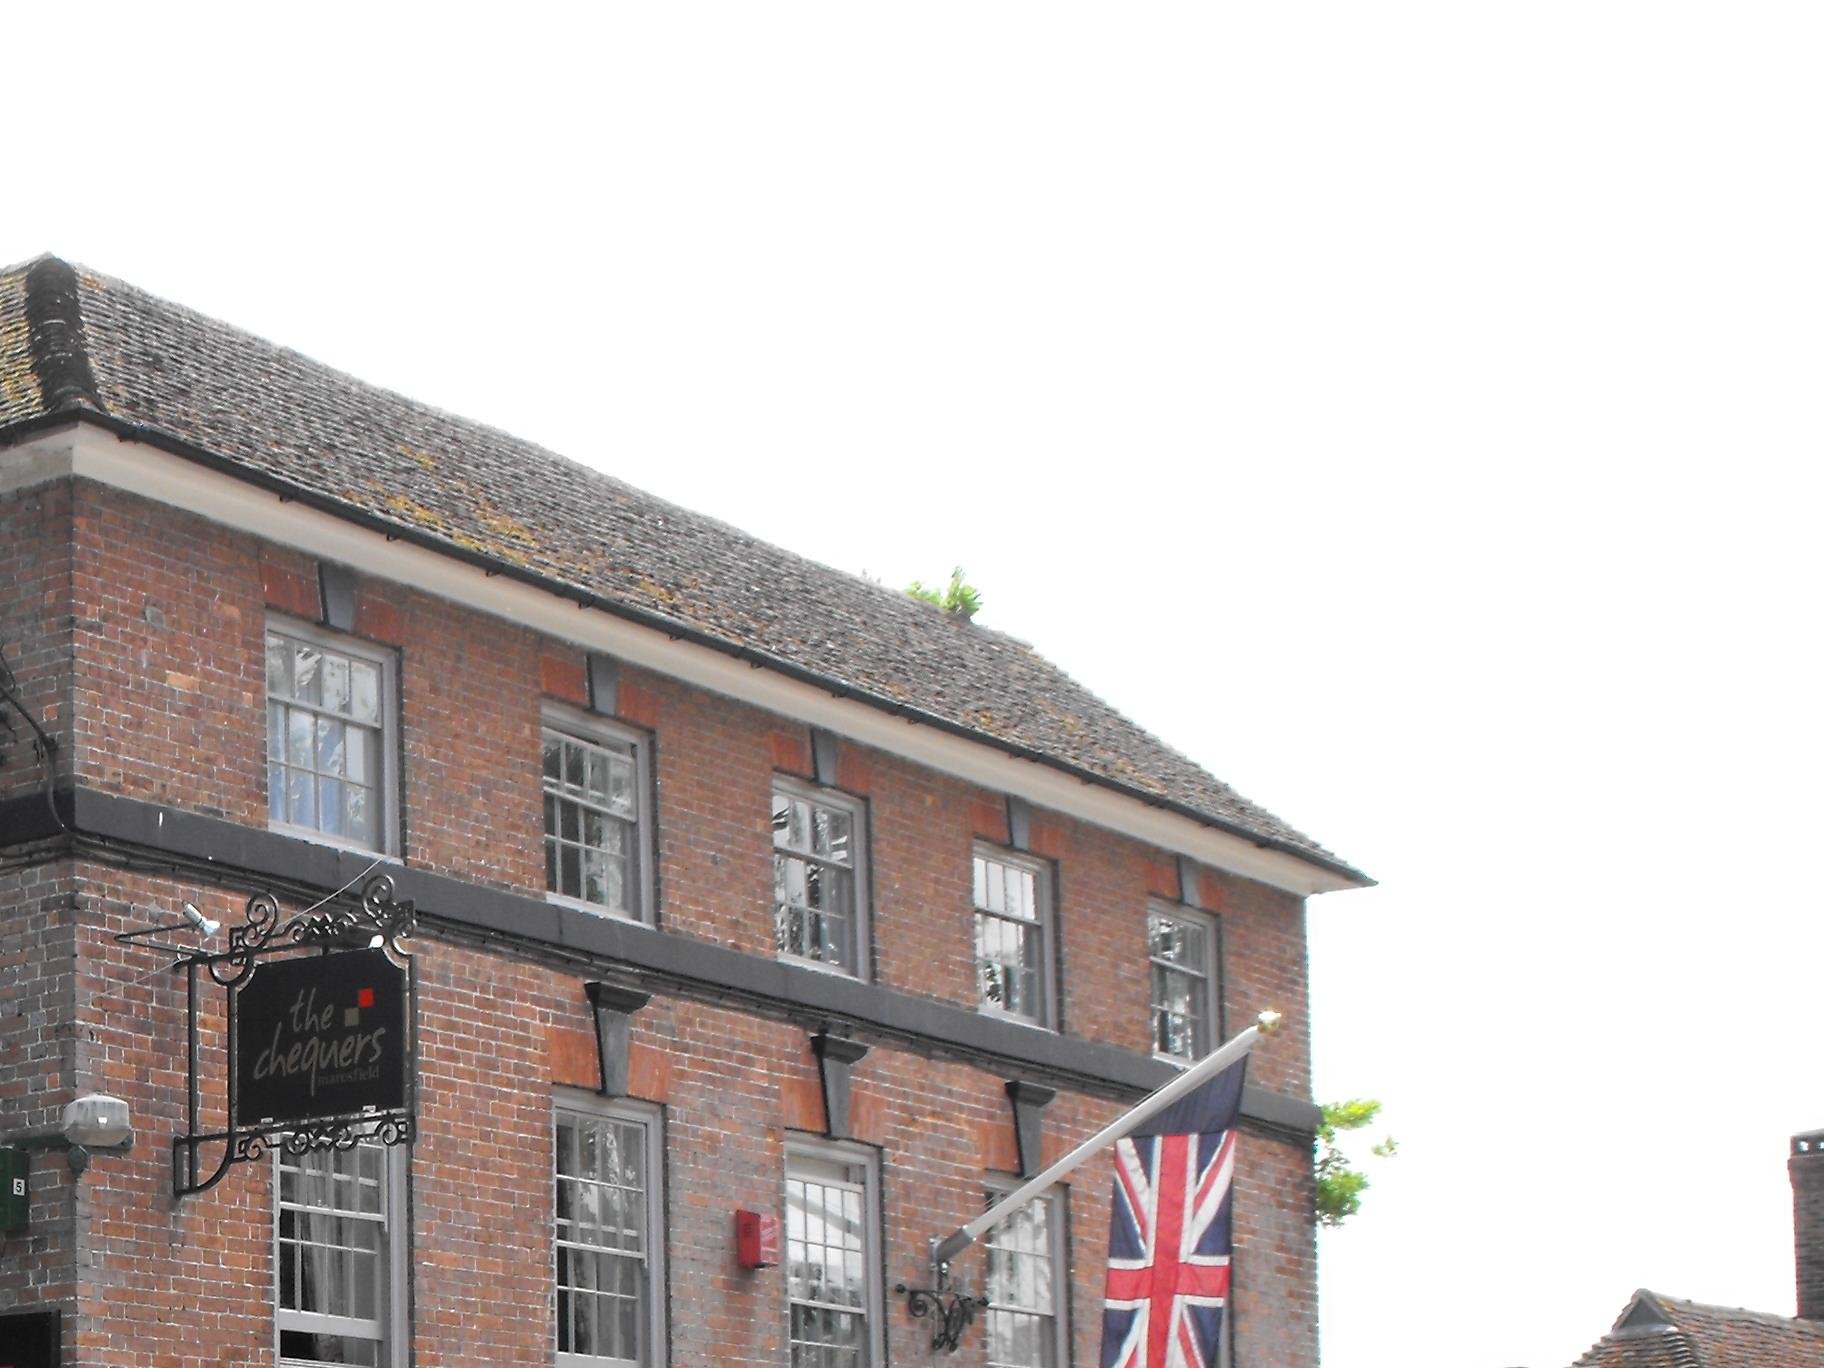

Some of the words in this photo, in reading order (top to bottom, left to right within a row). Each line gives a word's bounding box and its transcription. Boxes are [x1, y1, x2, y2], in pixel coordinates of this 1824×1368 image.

[290, 987, 335, 1032] the
[253, 1021, 386, 1097] chequers
[318, 1066, 380, 1087] maresfield
[15, 1181, 23, 1193] 5
